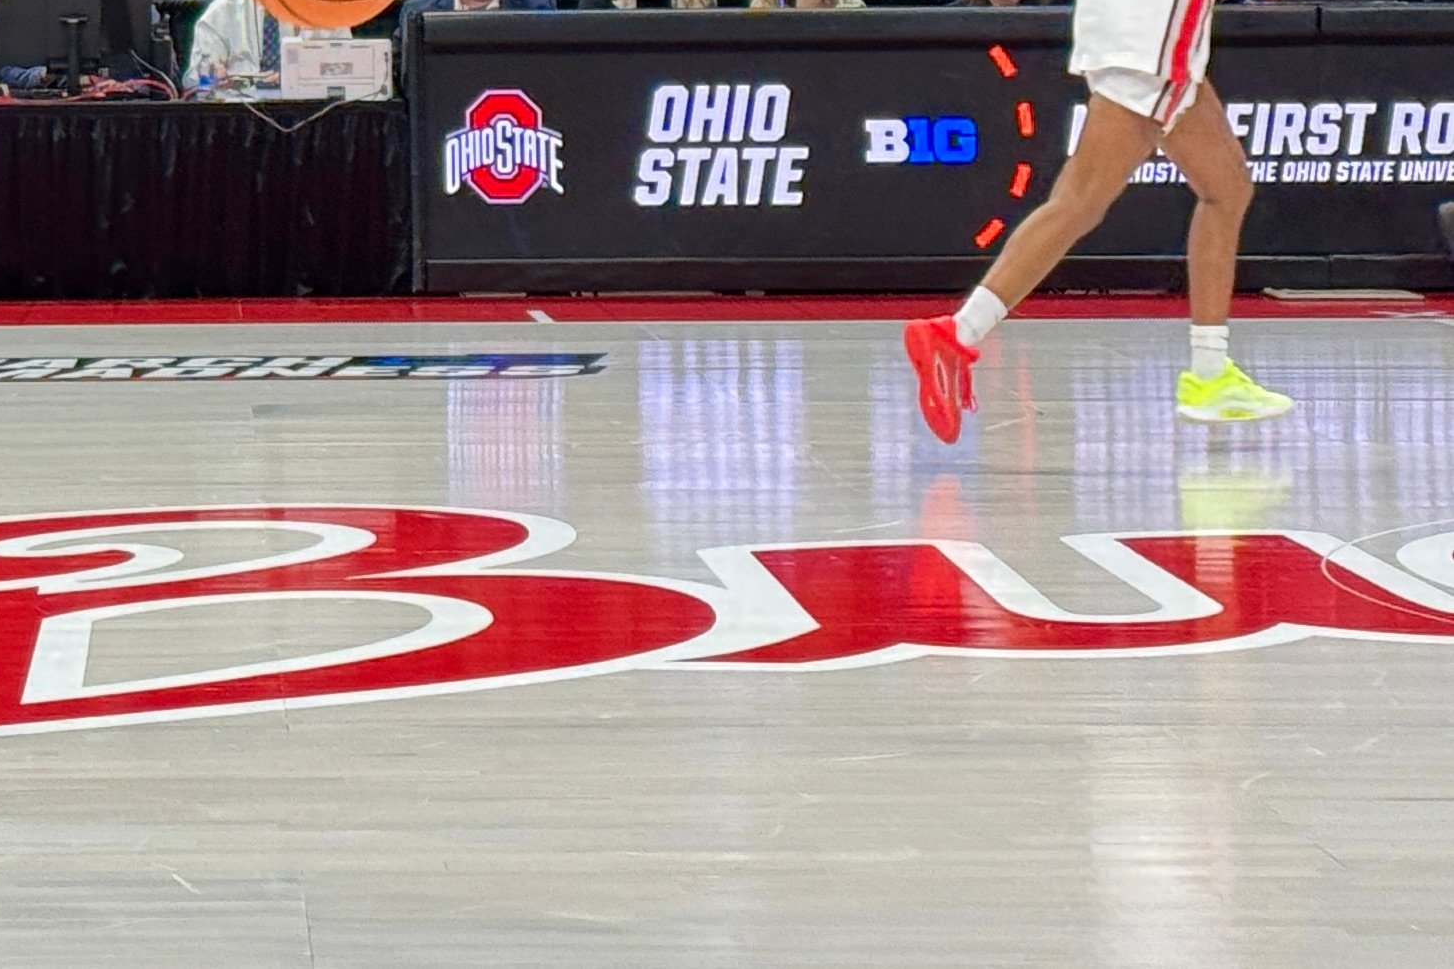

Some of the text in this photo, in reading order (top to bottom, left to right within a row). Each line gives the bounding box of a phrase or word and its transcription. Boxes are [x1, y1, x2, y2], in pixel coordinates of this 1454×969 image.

[646, 83, 793, 144] OHIO
[1226, 102, 1378, 156] FIRST
[633, 146, 811, 207] STATE
[1282, 161, 1331, 183] OHIO
[1336, 161, 1396, 183] STATE
